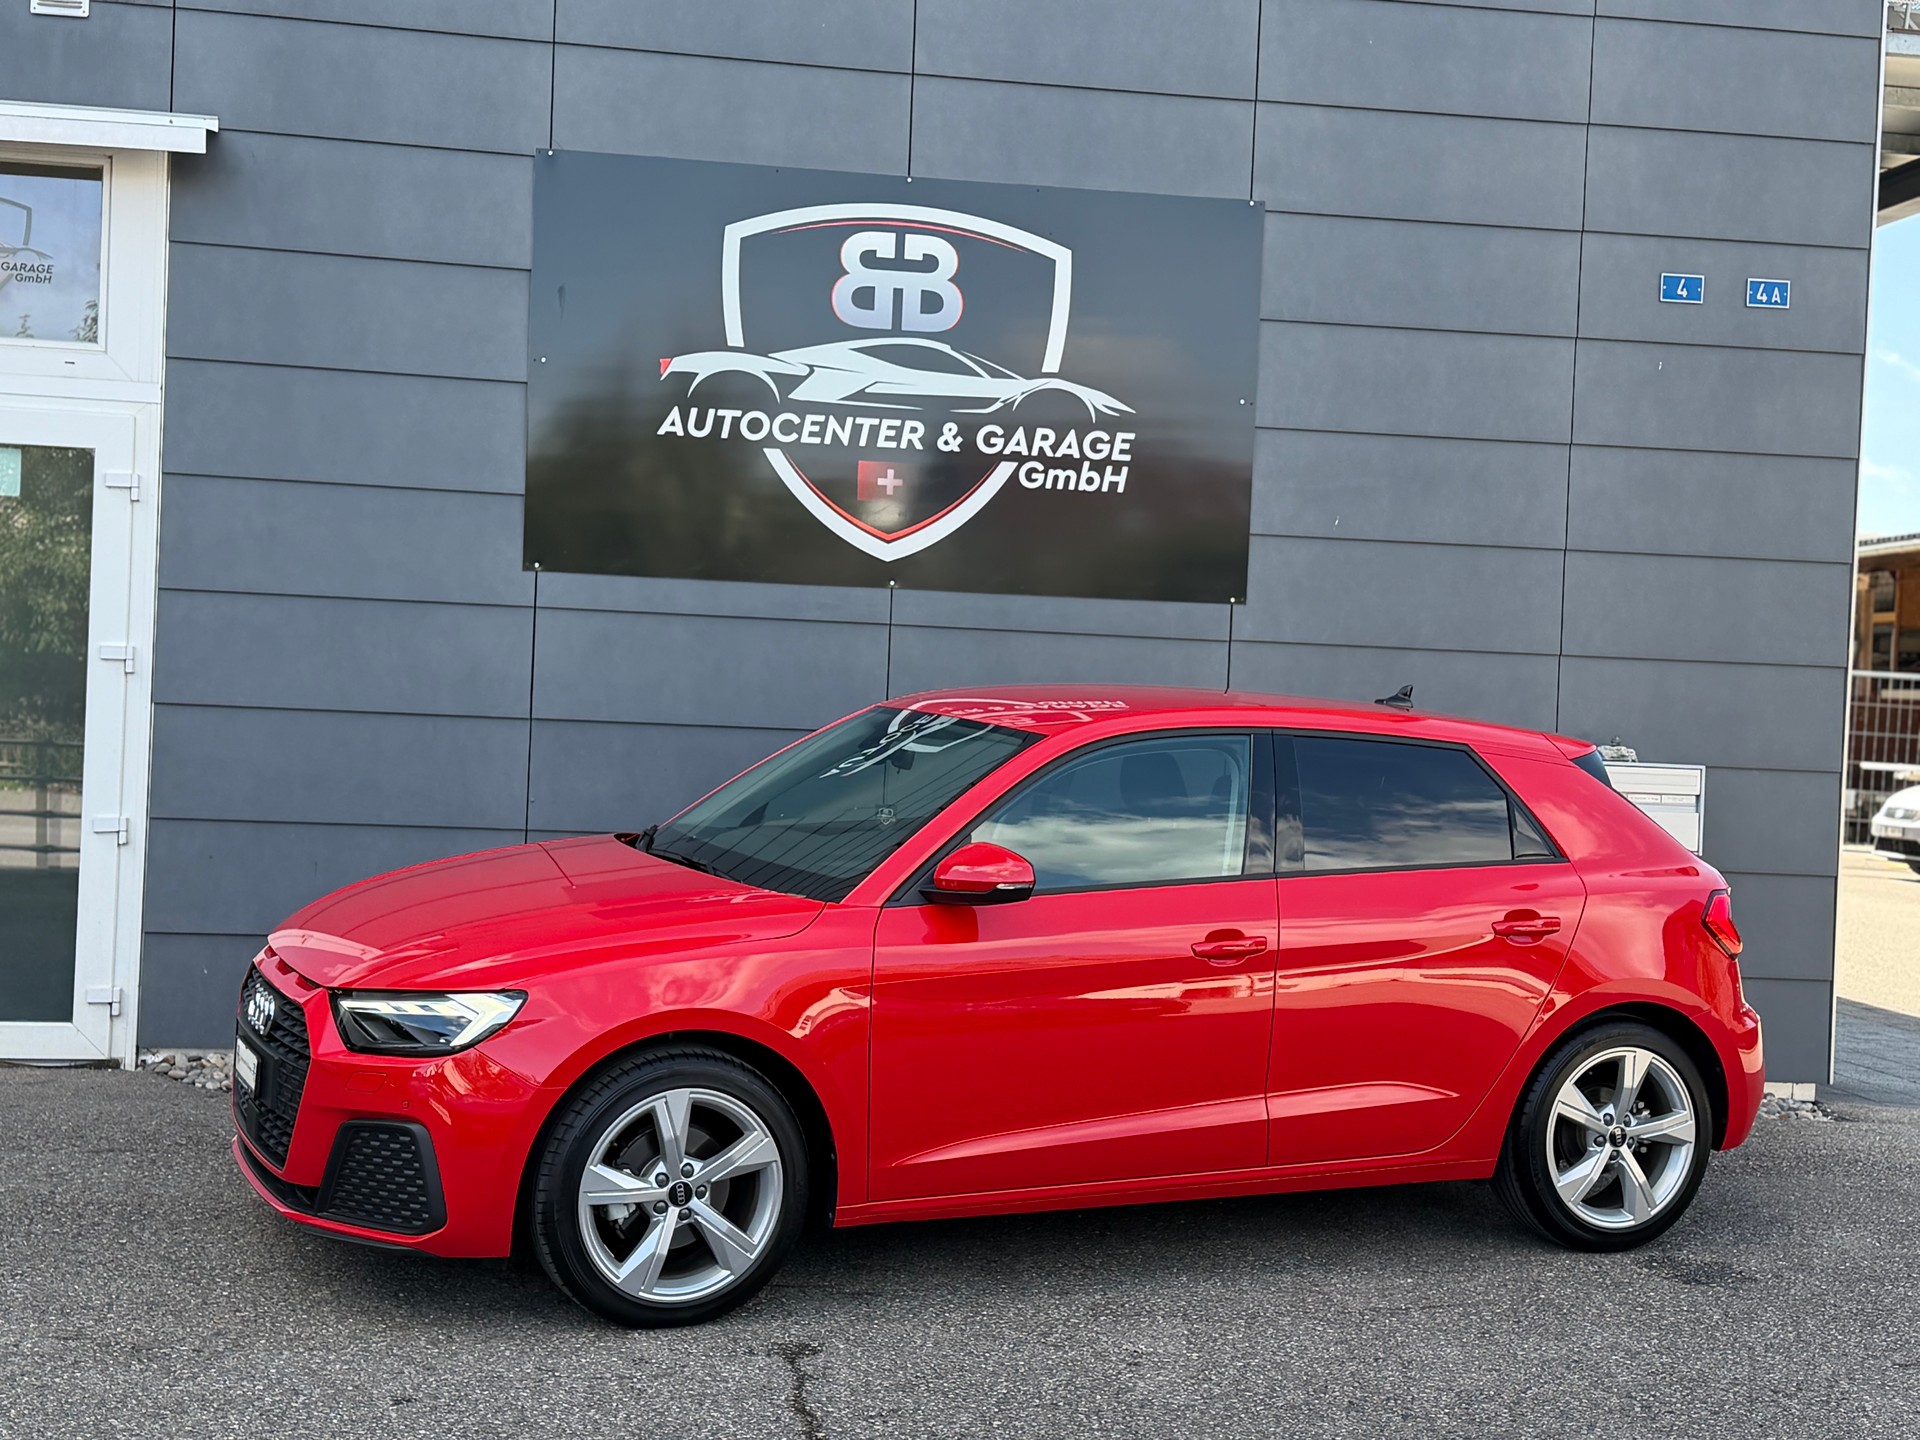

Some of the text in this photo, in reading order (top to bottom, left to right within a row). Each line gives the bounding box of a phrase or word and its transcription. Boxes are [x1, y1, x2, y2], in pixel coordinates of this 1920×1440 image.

[1, 261, 54, 274] GARAGE
[14, 273, 52, 284] GmbH
[1676, 278, 1688, 298] 4
[656, 405, 1136, 462] AUTOCENTER & GARAGE
[1018, 460, 1129, 494] GmbH
